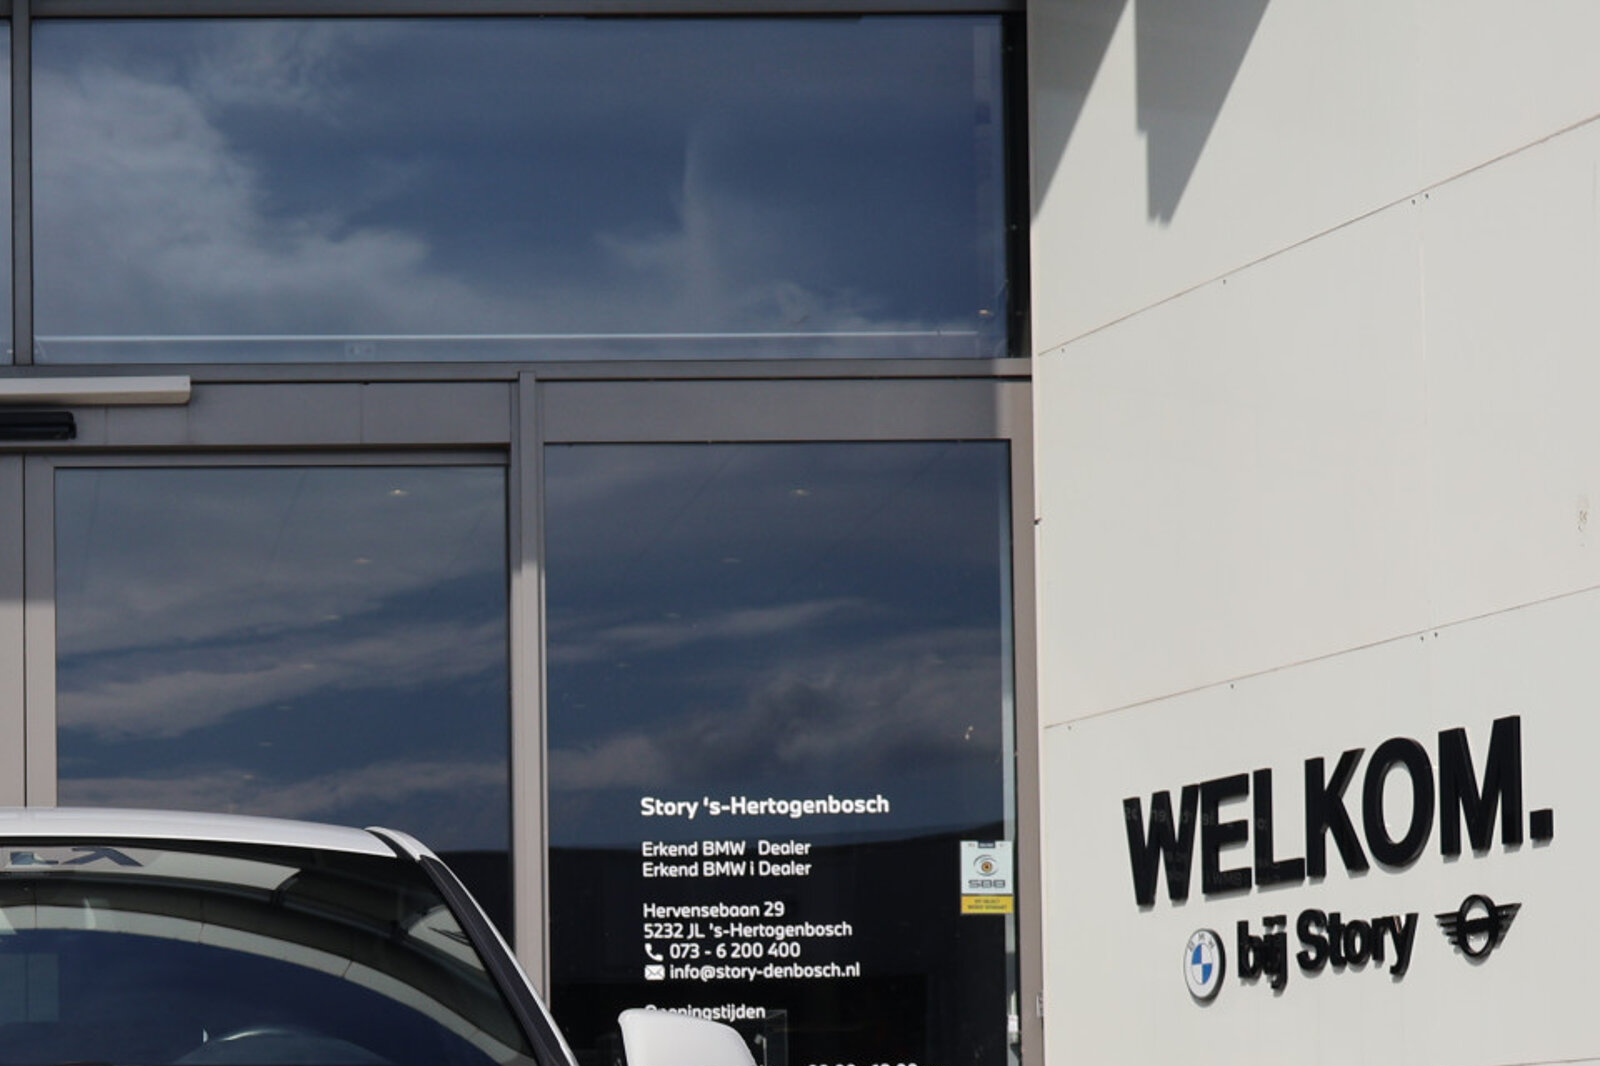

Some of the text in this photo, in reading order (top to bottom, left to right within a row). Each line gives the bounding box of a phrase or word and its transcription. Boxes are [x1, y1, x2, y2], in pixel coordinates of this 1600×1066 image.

[641, 795, 890, 819] Story 's-Hertogenbosch
[1123, 715, 1553, 907] WELKOM.
[642, 840, 811, 856] Erkend BMW Dealer
[642, 860, 811, 877] Erkend BMW i Dealer
[643, 902, 785, 919] Hervensebaan 29
[643, 922, 853, 940] 5232 JL 's-Hertogenbosch
[670, 943, 700, 958] 073
[716, 943, 726, 958] 6
[731, 943, 763, 958] 200
[768, 942, 800, 957] 400
[1237, 909, 1419, 990] bij Story
[670, 963, 861, 981] info@story-denbosch.nl
